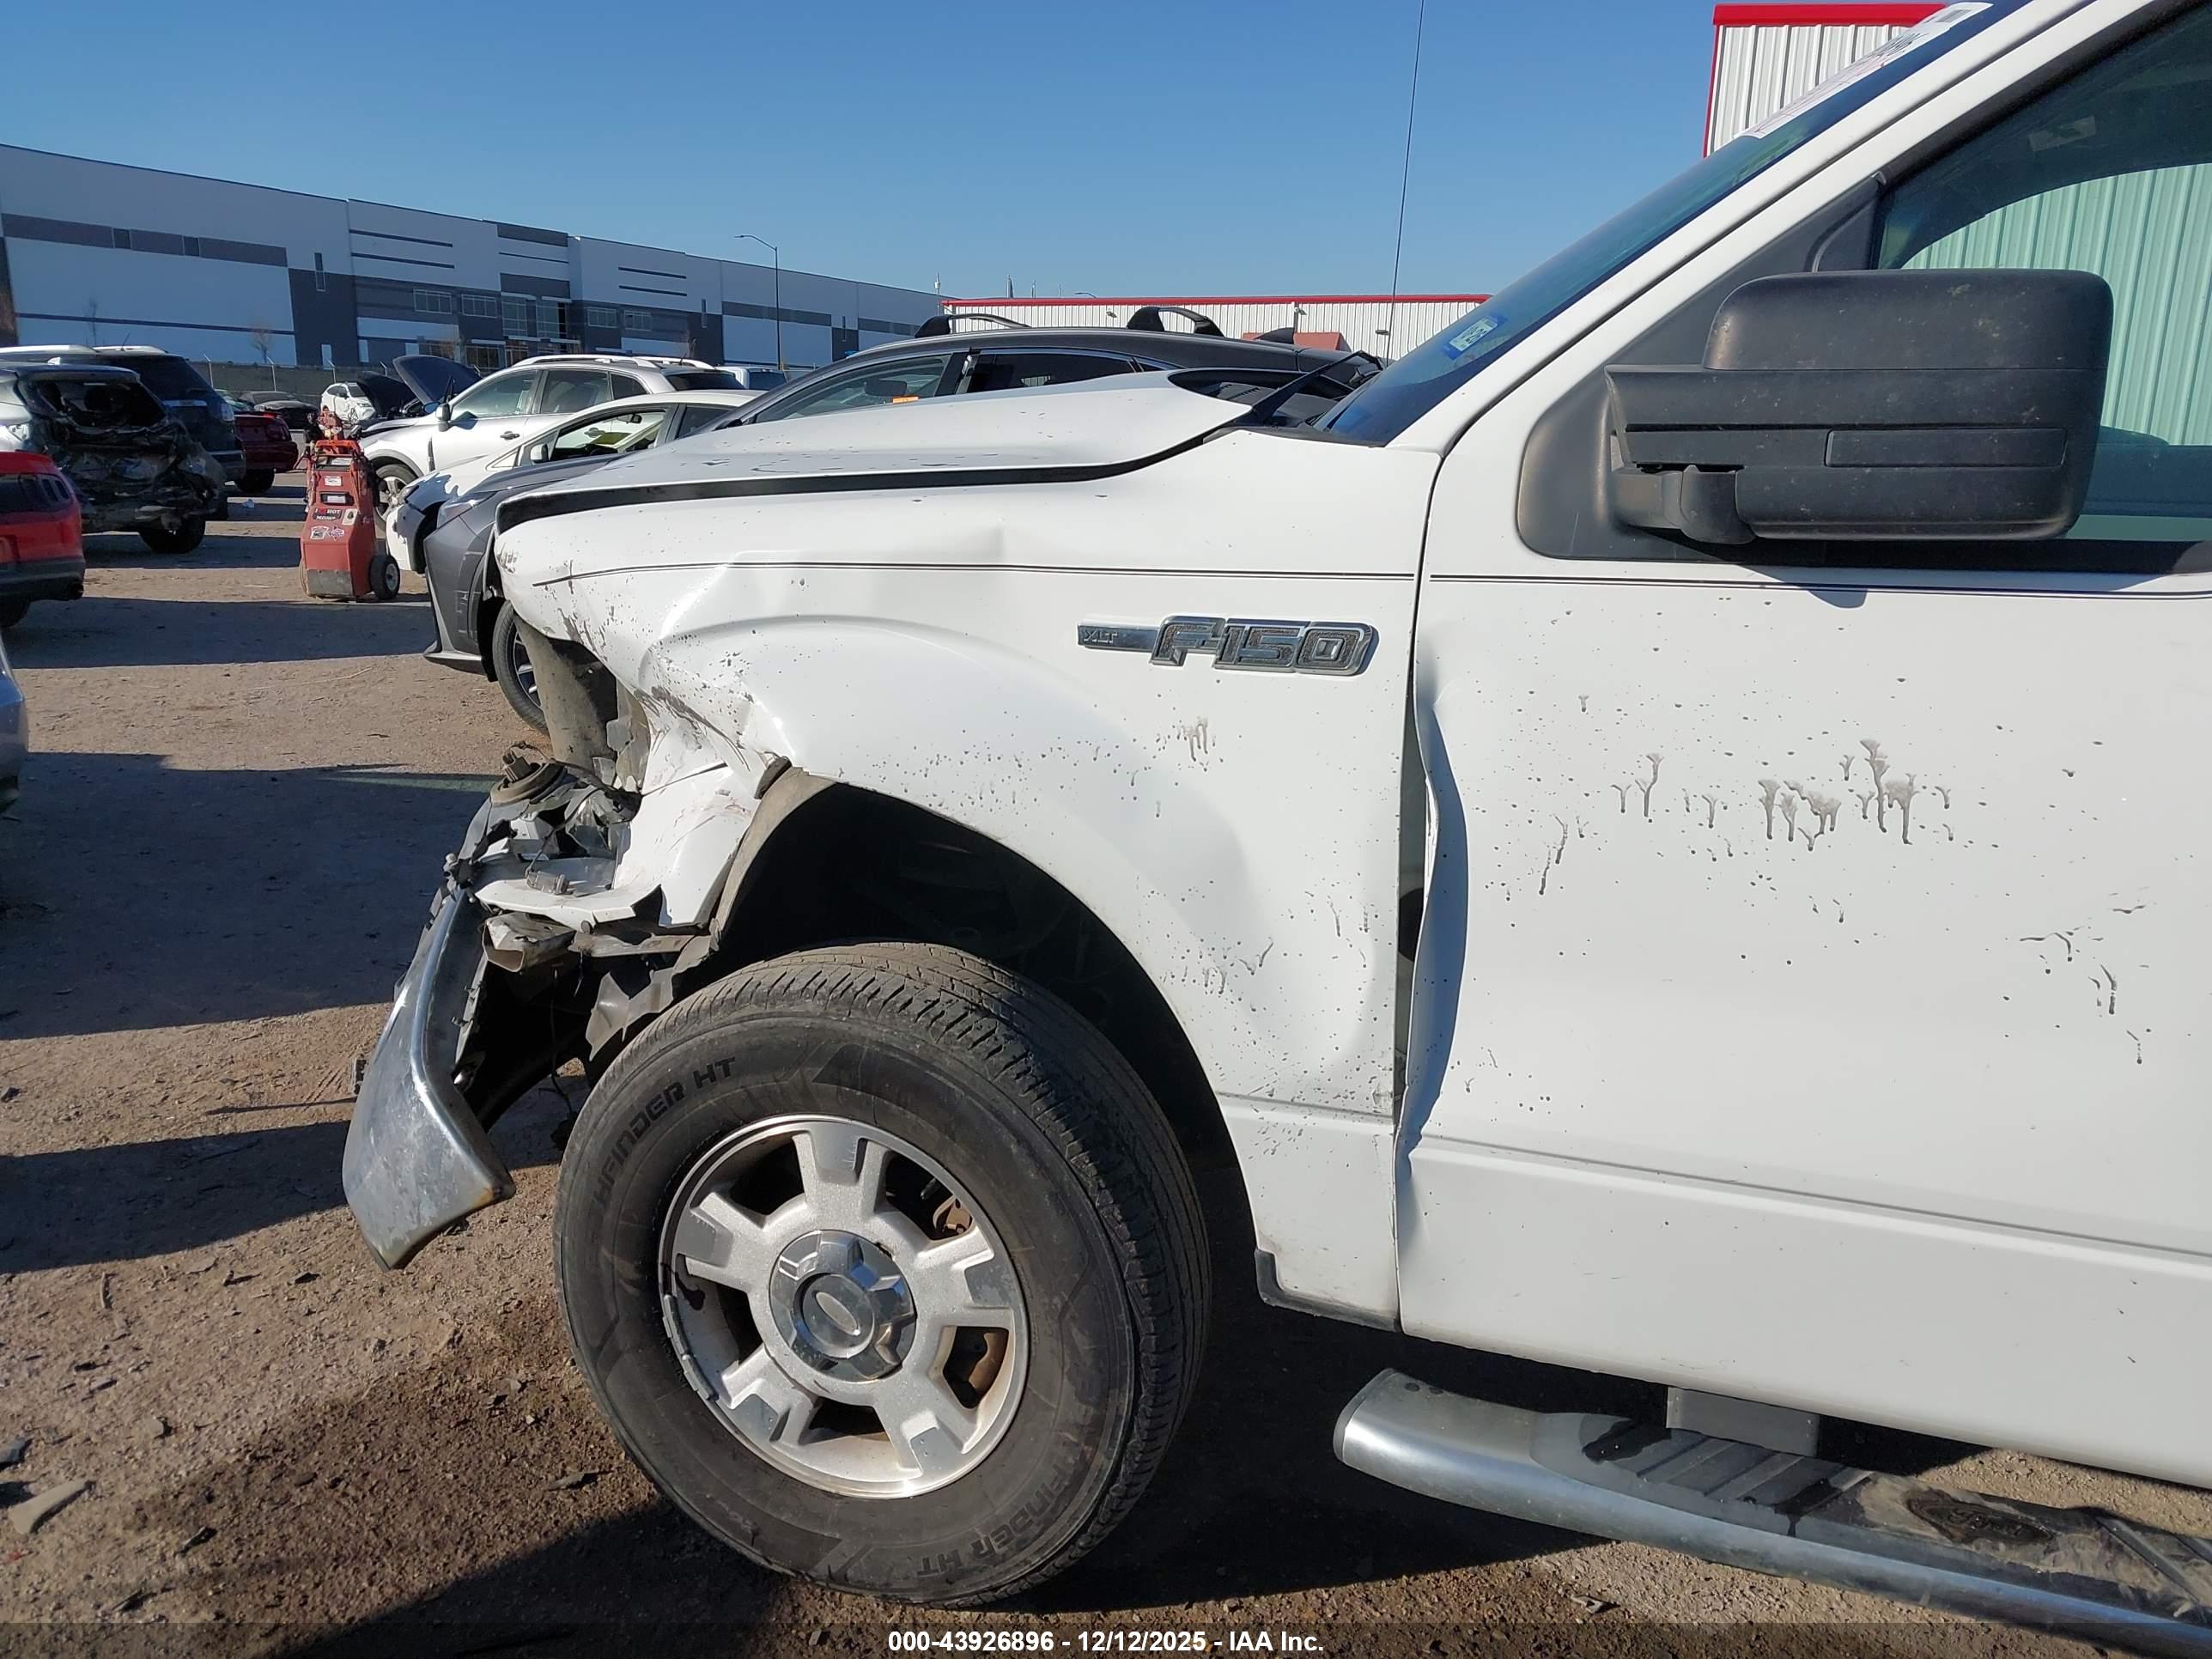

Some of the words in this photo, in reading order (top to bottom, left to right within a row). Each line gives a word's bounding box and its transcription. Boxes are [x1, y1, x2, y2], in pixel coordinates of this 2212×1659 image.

[1083, 629, 1119, 644] XLT
[1150, 616, 1377, 676] F-150
[693, 1056, 736, 1090] HT
[916, 1548, 963, 1577] HT
